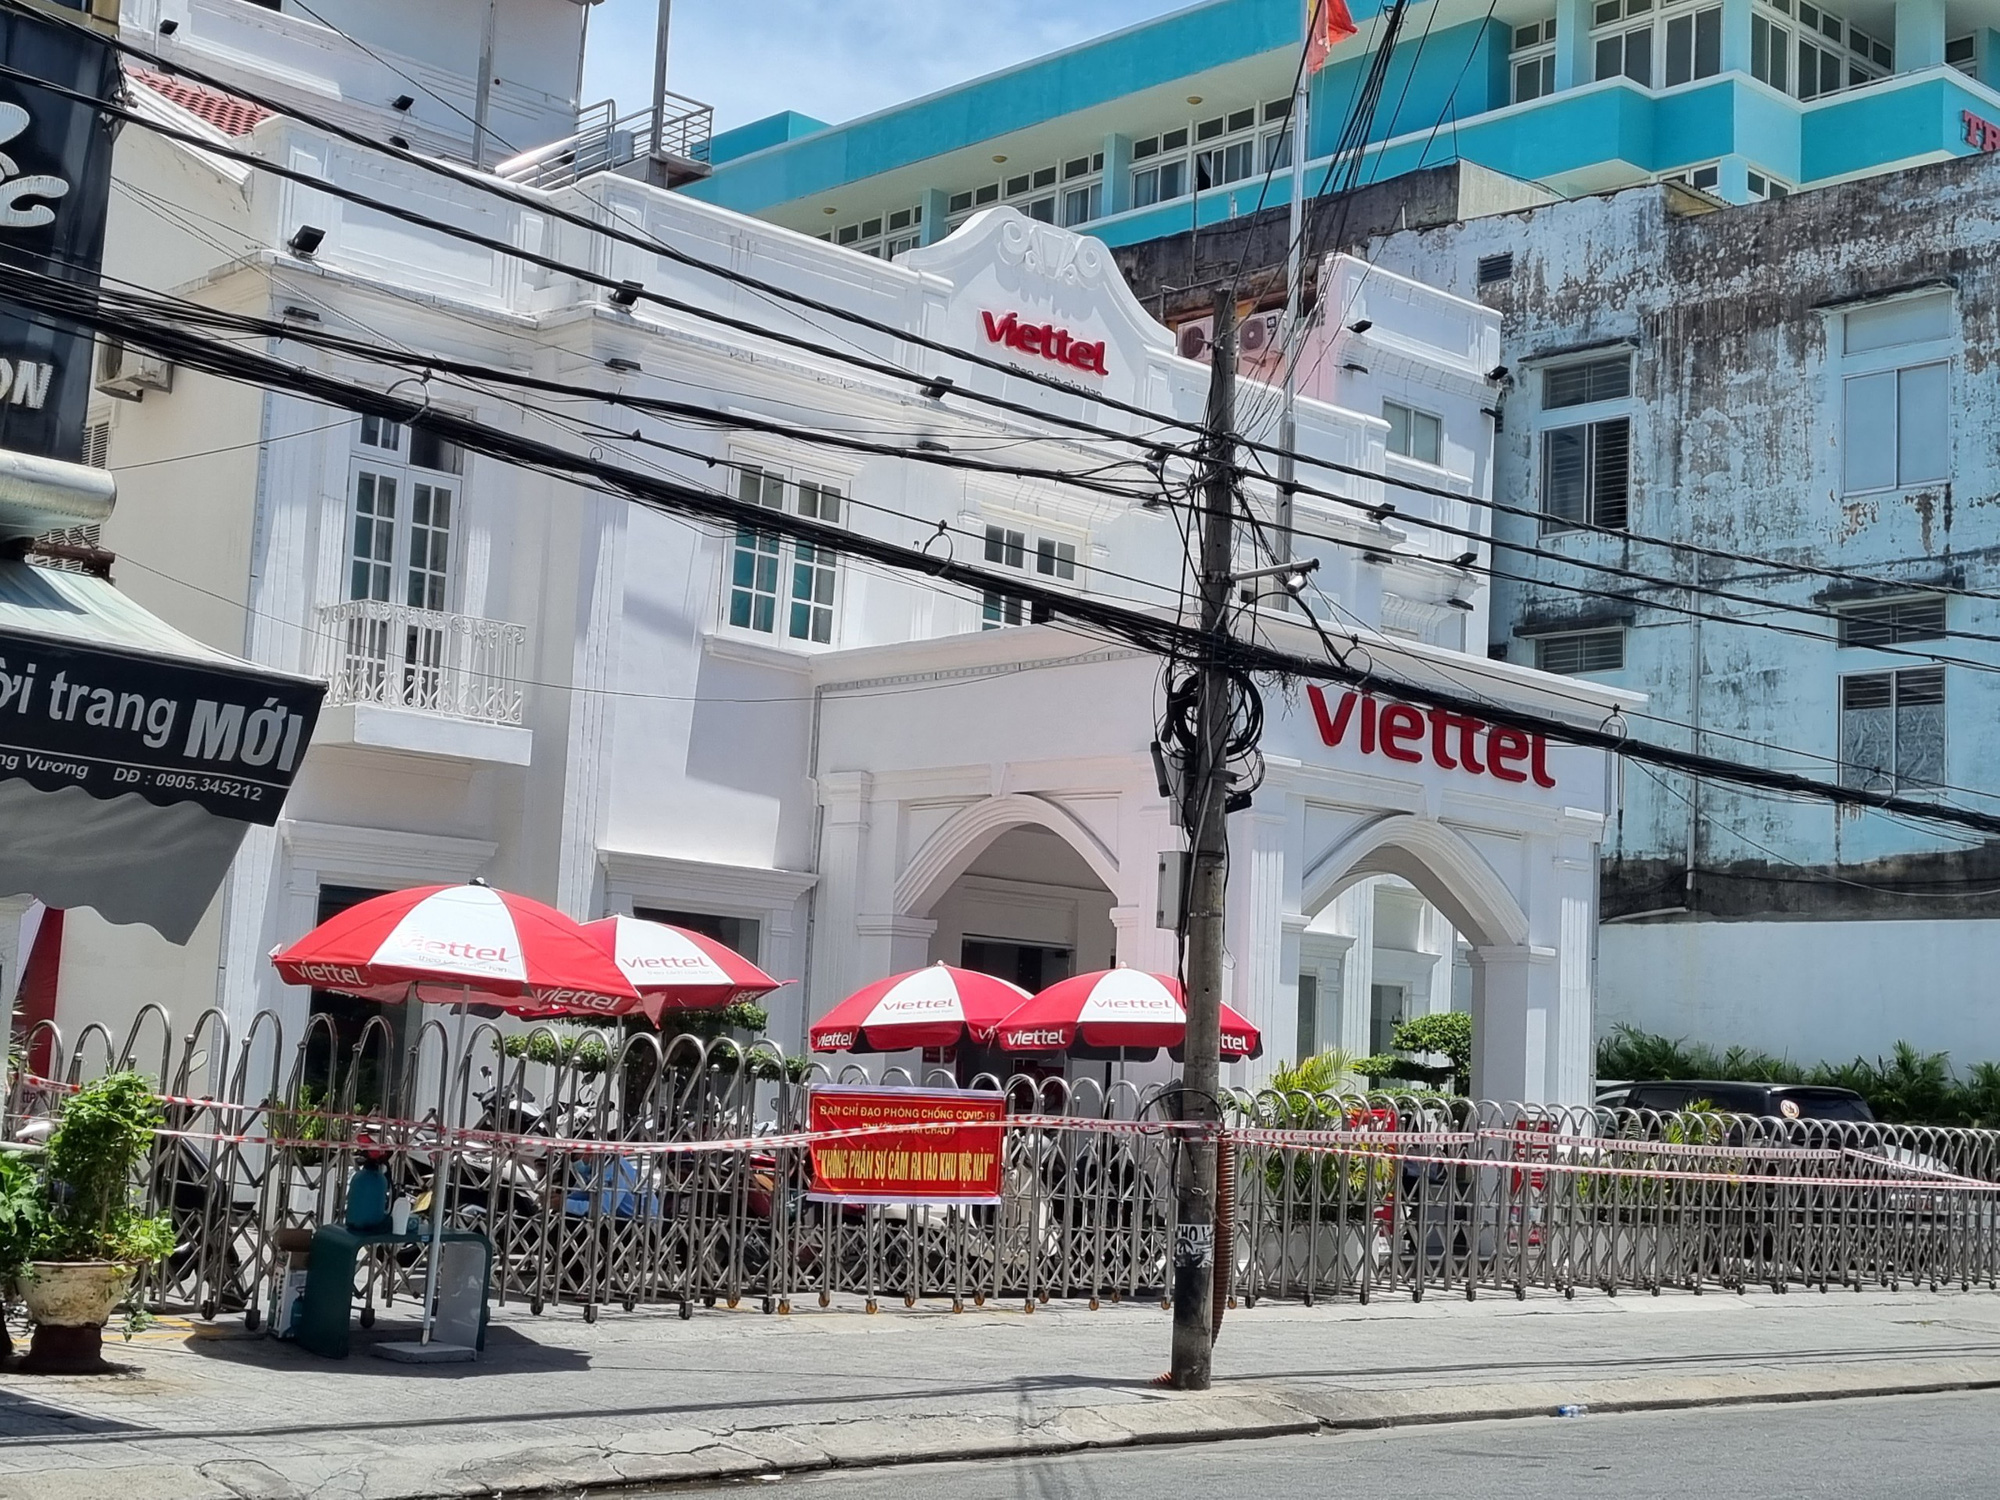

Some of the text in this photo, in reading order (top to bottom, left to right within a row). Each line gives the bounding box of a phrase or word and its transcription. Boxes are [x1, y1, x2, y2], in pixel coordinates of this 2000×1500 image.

[48, 669, 178, 749] trang
[183, 697, 303, 773] MỚI
[26, 754, 89, 779] Vương
[155, 773, 263, 801] 0905.345212
[621, 956, 709, 969] viettel
[289, 961, 368, 986] viettel
[536, 987, 623, 1011] viettel
[883, 998, 955, 1011] viettel
[1092, 999, 1173, 1009] viettel
[816, 1031, 853, 1047] viettel
[1007, 1028, 1066, 1047] viettel
[1220, 1033, 1249, 1051] ttel
[819, 1102, 996, 1121] BAN CHỈ ĐẠO PHÒNG CHỐNG COVID-19
[888, 1140, 909, 1181] CẤM
[910, 1151, 922, 1181] RA
[923, 1145, 939, 1182] VÀO
[939, 1152, 957, 1182] KHU
